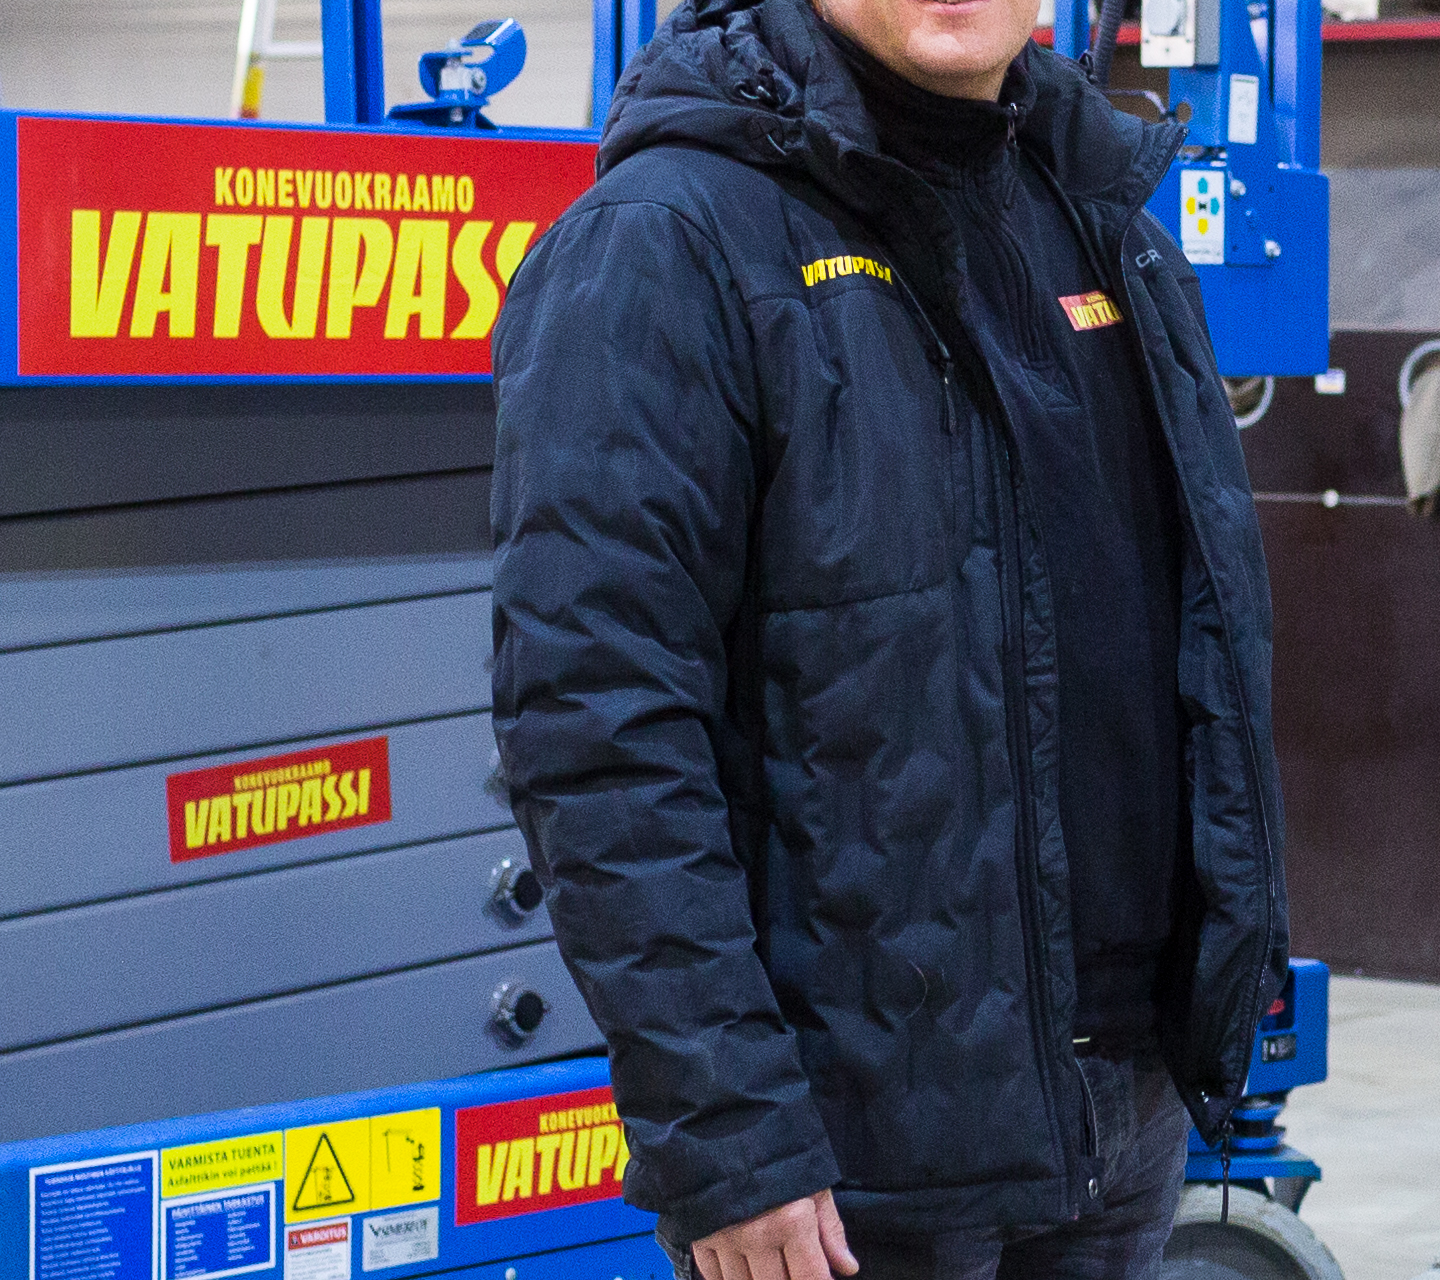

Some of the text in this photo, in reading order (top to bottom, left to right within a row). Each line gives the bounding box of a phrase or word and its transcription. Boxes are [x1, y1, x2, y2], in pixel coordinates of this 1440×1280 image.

[214, 166, 475, 214] KONEVUOKRAAMO
[69, 209, 538, 340] VATUPAS
[184, 767, 372, 851] VATUPASSI
[169, 1143, 276, 1171] VARMISTA TUENTA
